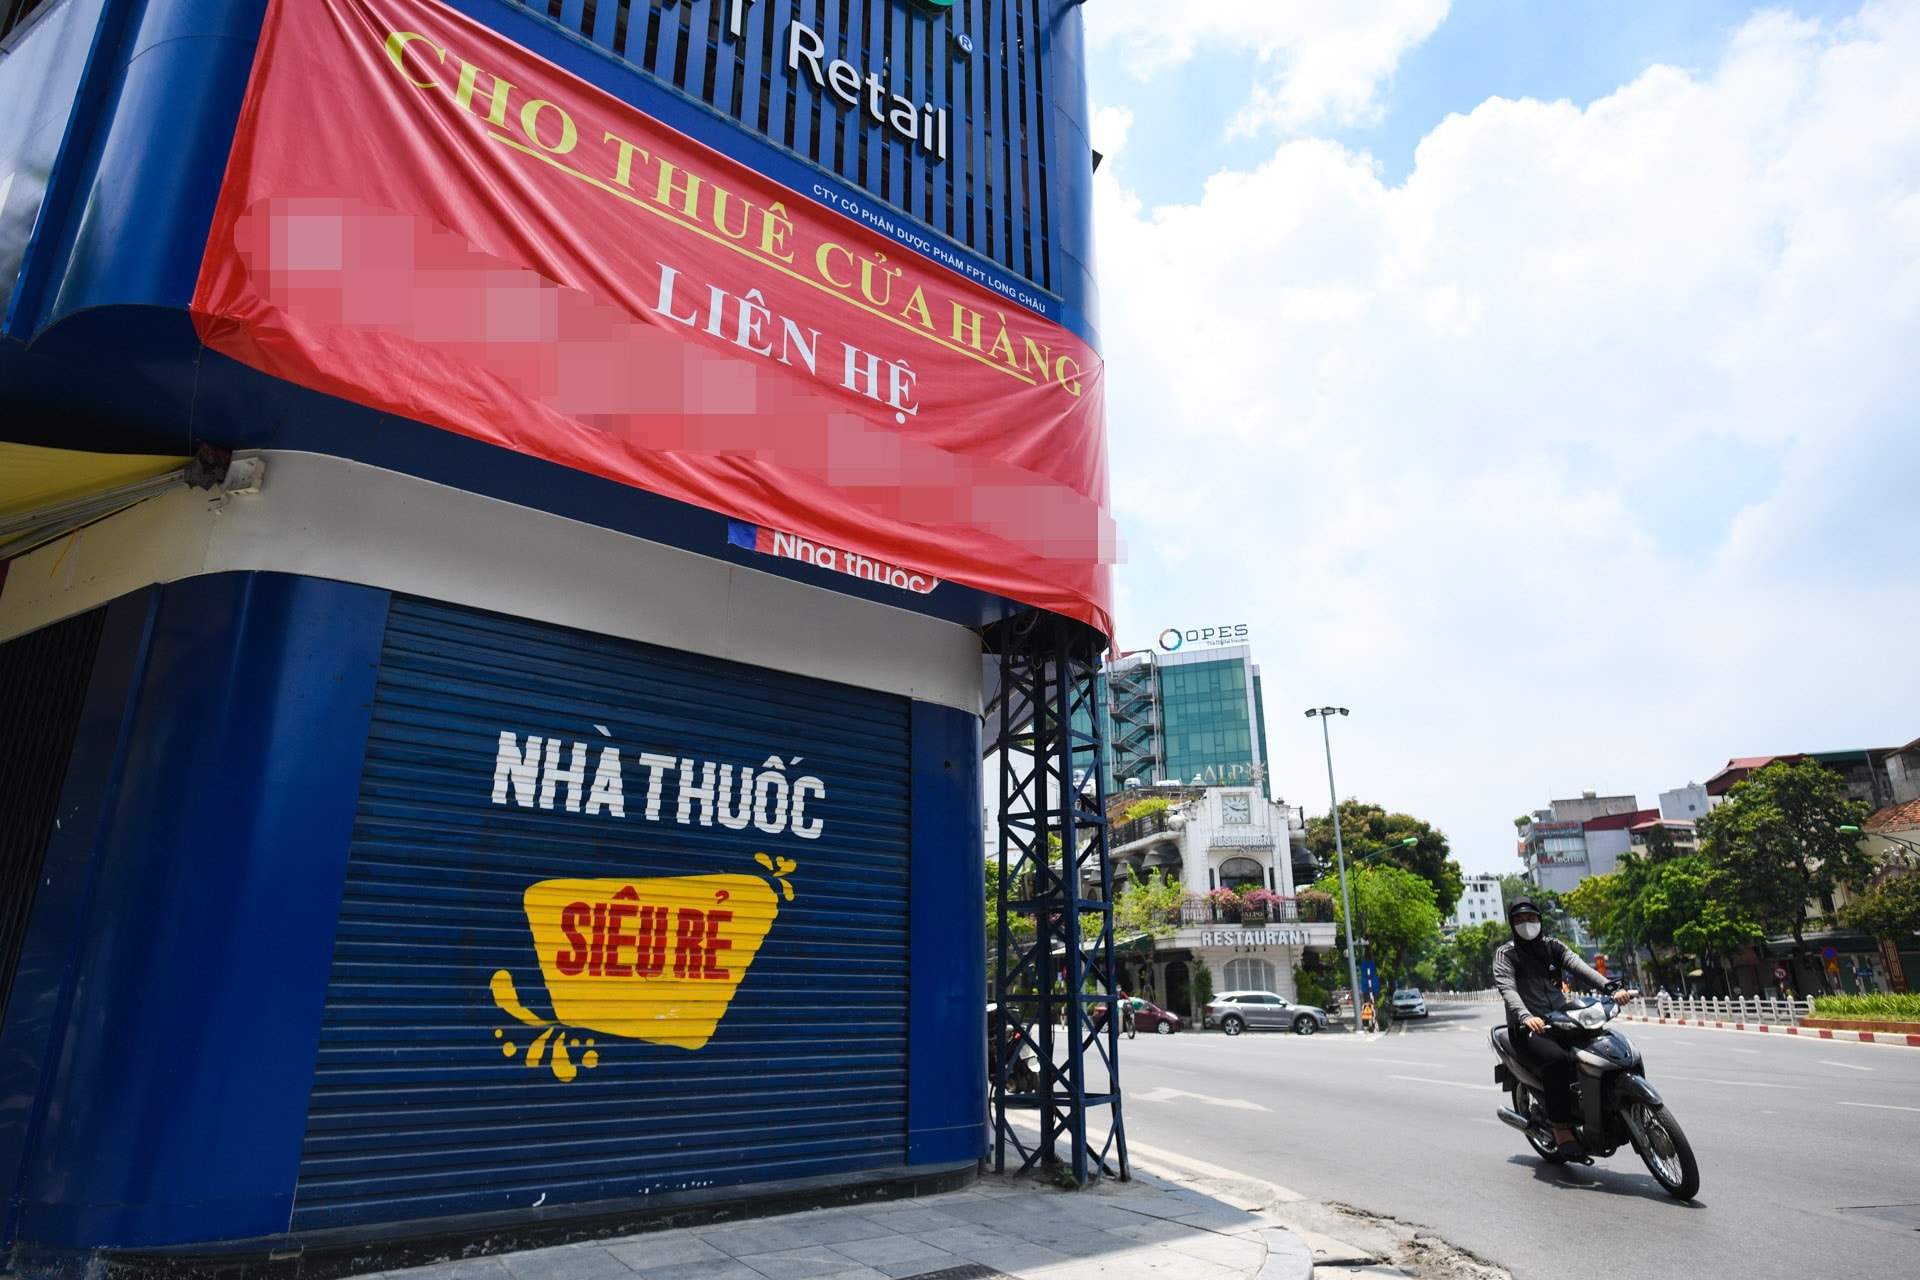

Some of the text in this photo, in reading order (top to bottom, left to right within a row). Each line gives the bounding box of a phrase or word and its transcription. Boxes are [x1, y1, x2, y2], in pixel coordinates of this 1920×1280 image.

[788, 19, 946, 160] Retail
[385, 31, 1082, 397] CHO THUÊ CỬA HÀNG
[813, 184, 839, 203] CTY
[897, 228, 930, 253] DƯỢC
[966, 264, 987, 282] FPT
[988, 276, 1016, 298] LONG
[1018, 292, 1046, 313] CHÂU
[650, 261, 920, 424] LIÊN HỆ
[1185, 623, 1249, 642] OPES
[492, 724, 826, 839] NHÀ THUỐC
[556, 885, 734, 980] SIÊU RẺ
[1201, 929, 1312, 947] RESTAURANT
